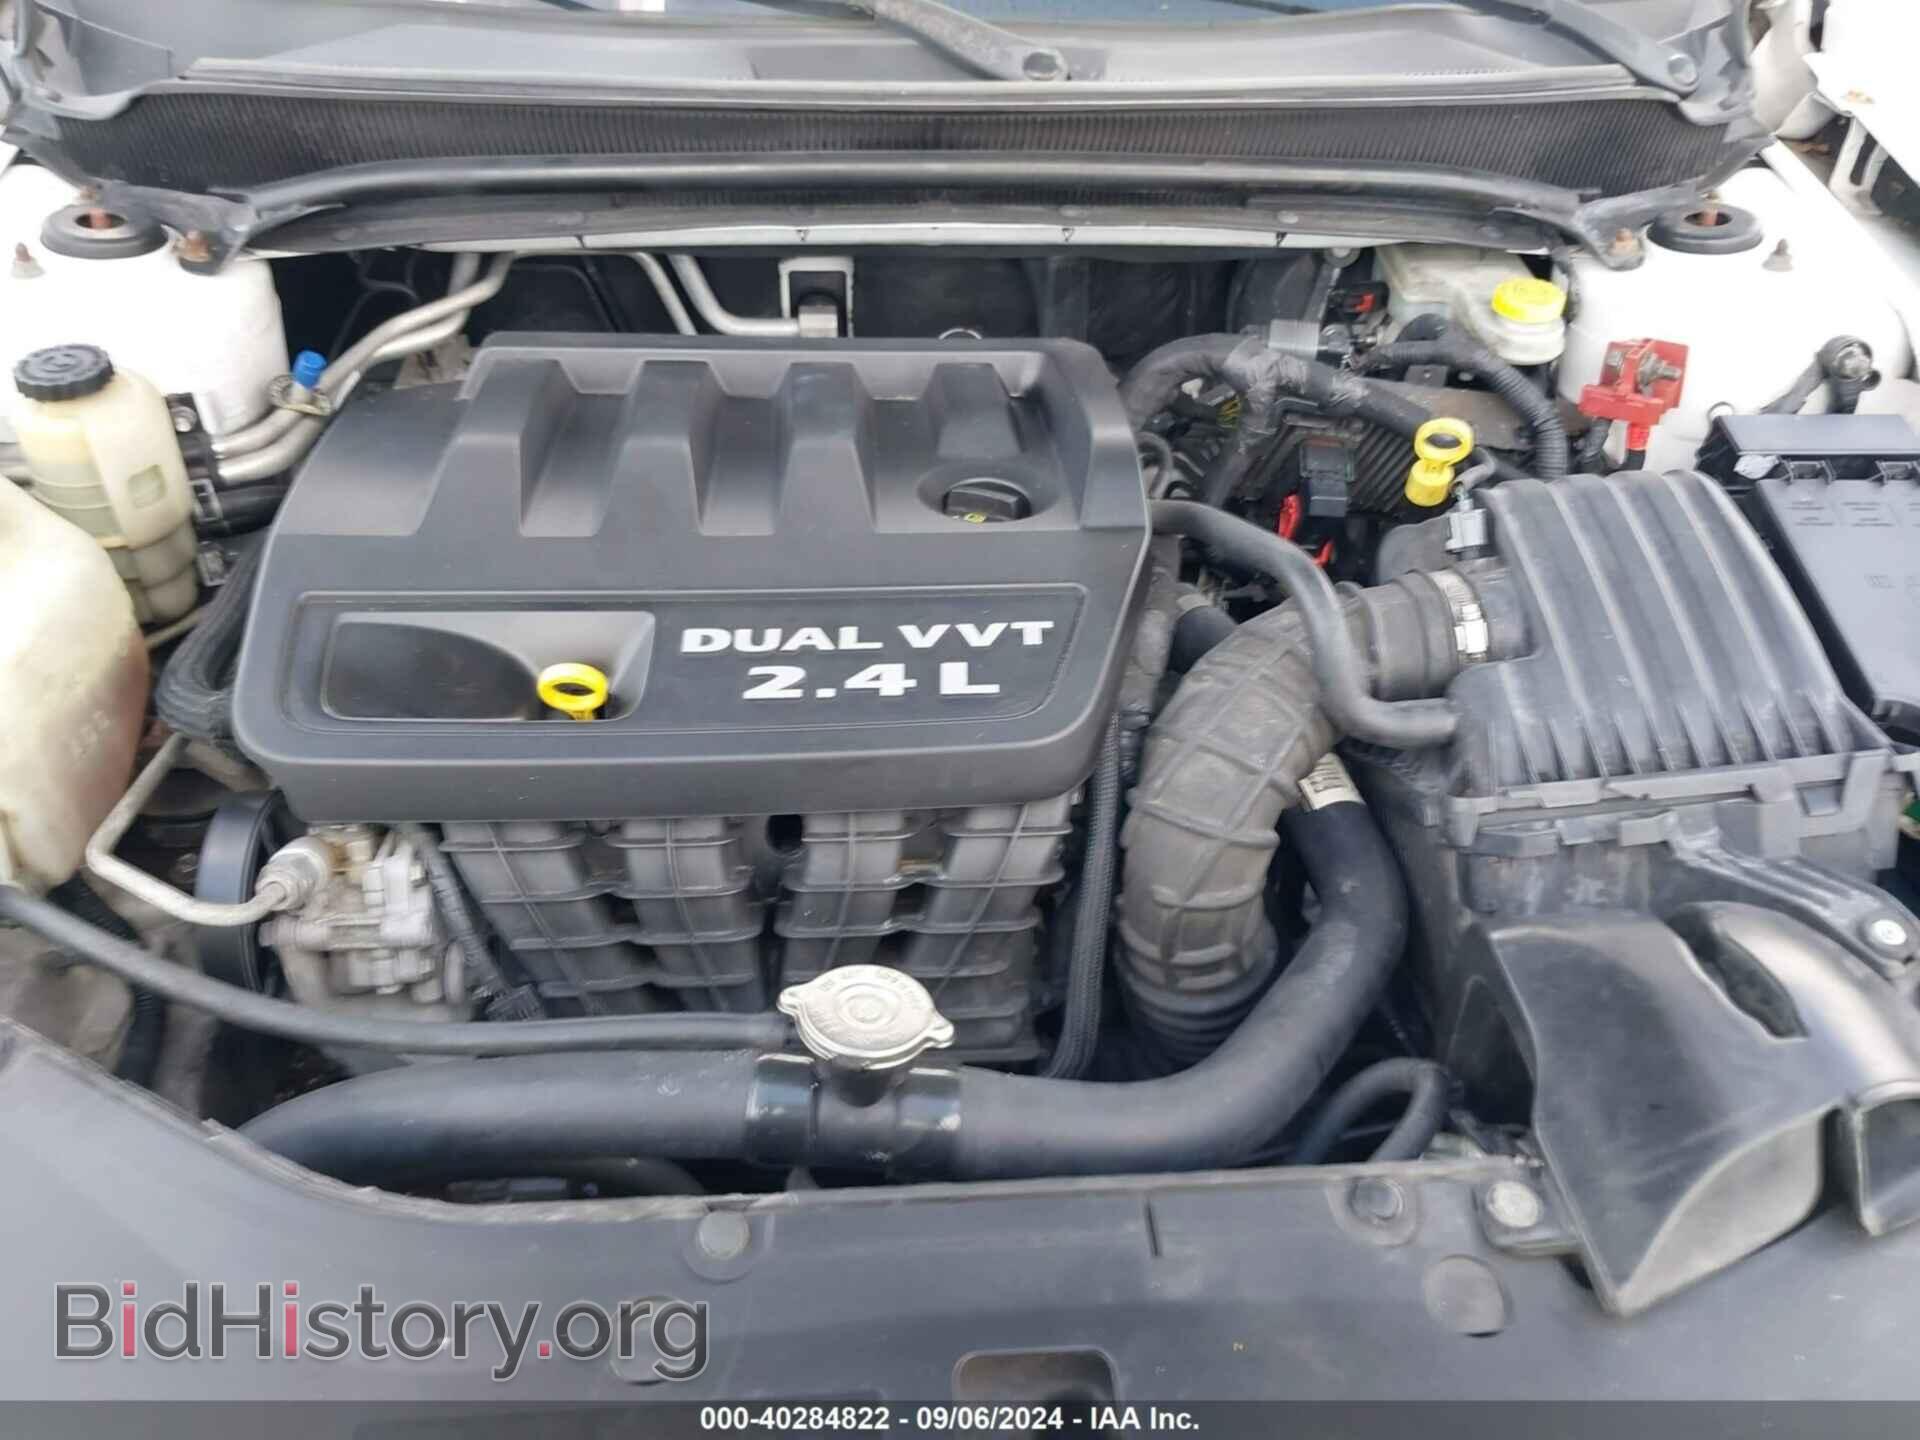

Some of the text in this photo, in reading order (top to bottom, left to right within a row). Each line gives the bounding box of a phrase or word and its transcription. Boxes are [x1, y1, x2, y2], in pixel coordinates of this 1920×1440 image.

[681, 621, 1054, 652] DUAL VVT
[742, 661, 1001, 700] 2.4 L
